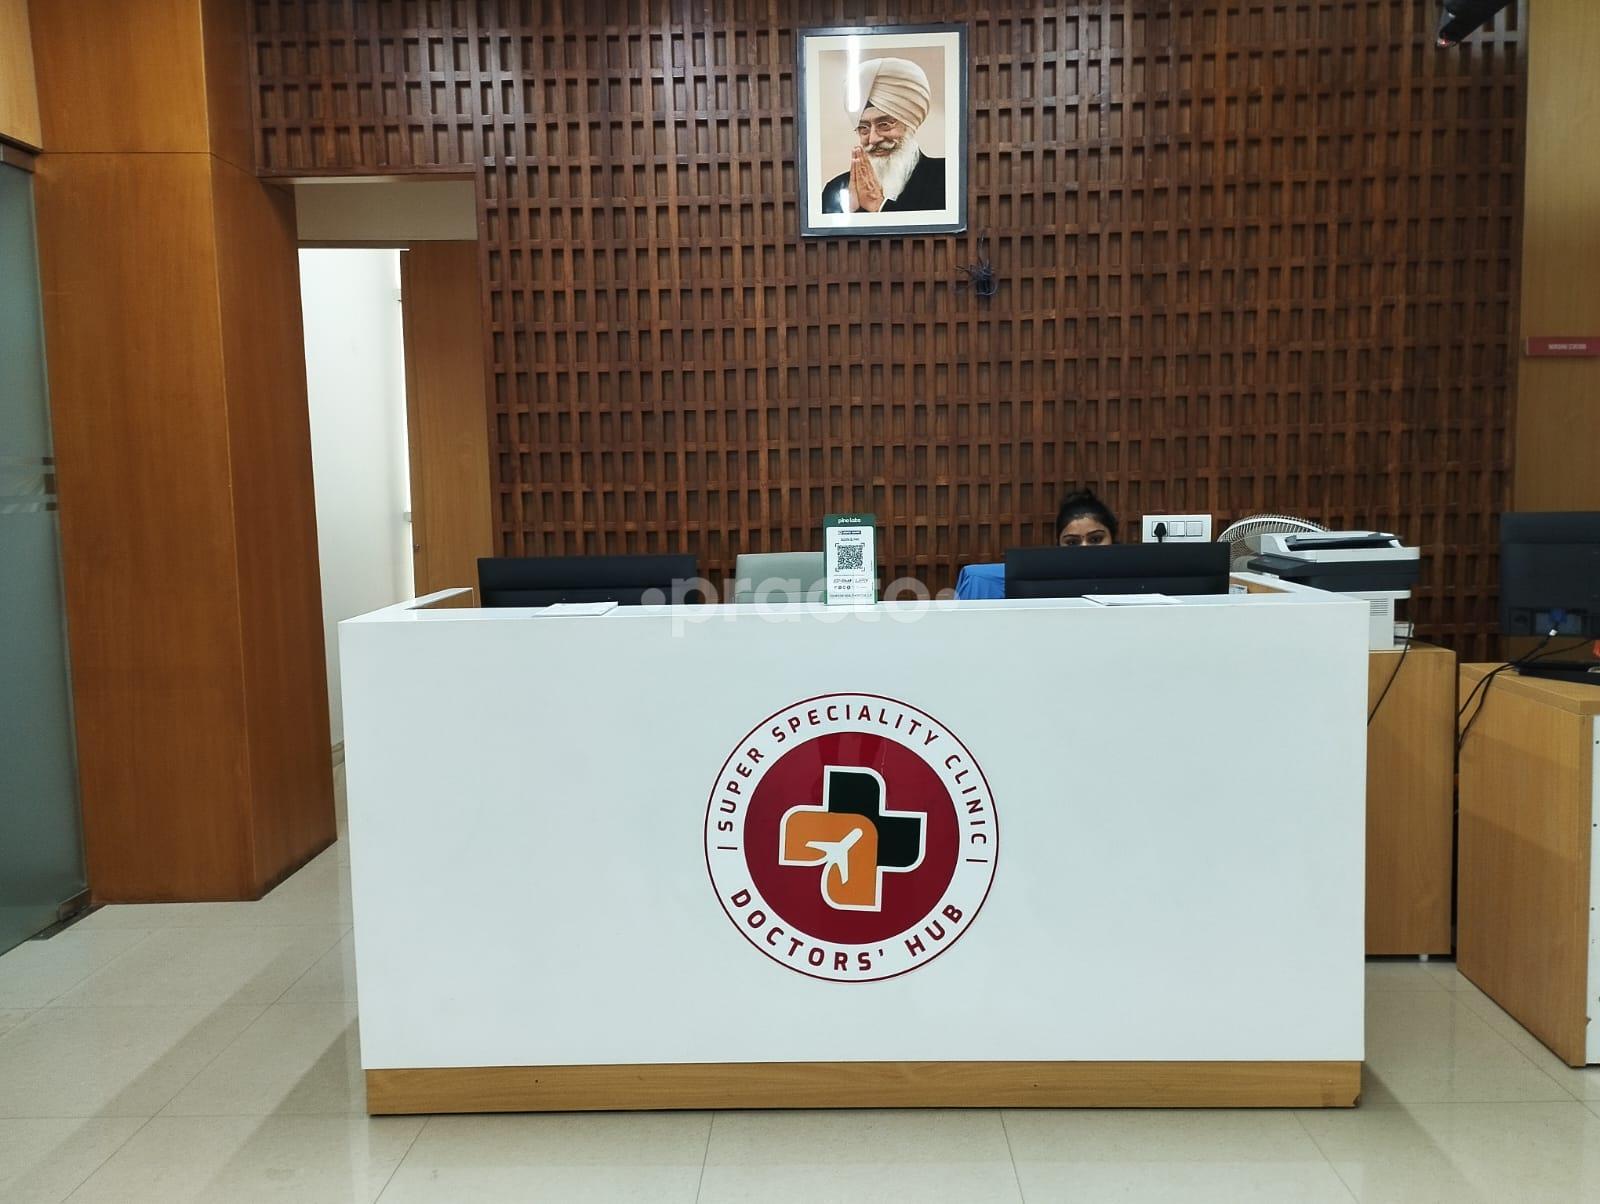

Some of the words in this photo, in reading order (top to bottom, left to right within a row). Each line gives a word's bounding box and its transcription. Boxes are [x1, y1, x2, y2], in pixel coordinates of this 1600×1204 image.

[717, 747, 765, 833] SUPER
[771, 704, 940, 747] SPECIALITY
[944, 754, 987, 845] CLINIC
[903, 904, 963, 958] HUB
